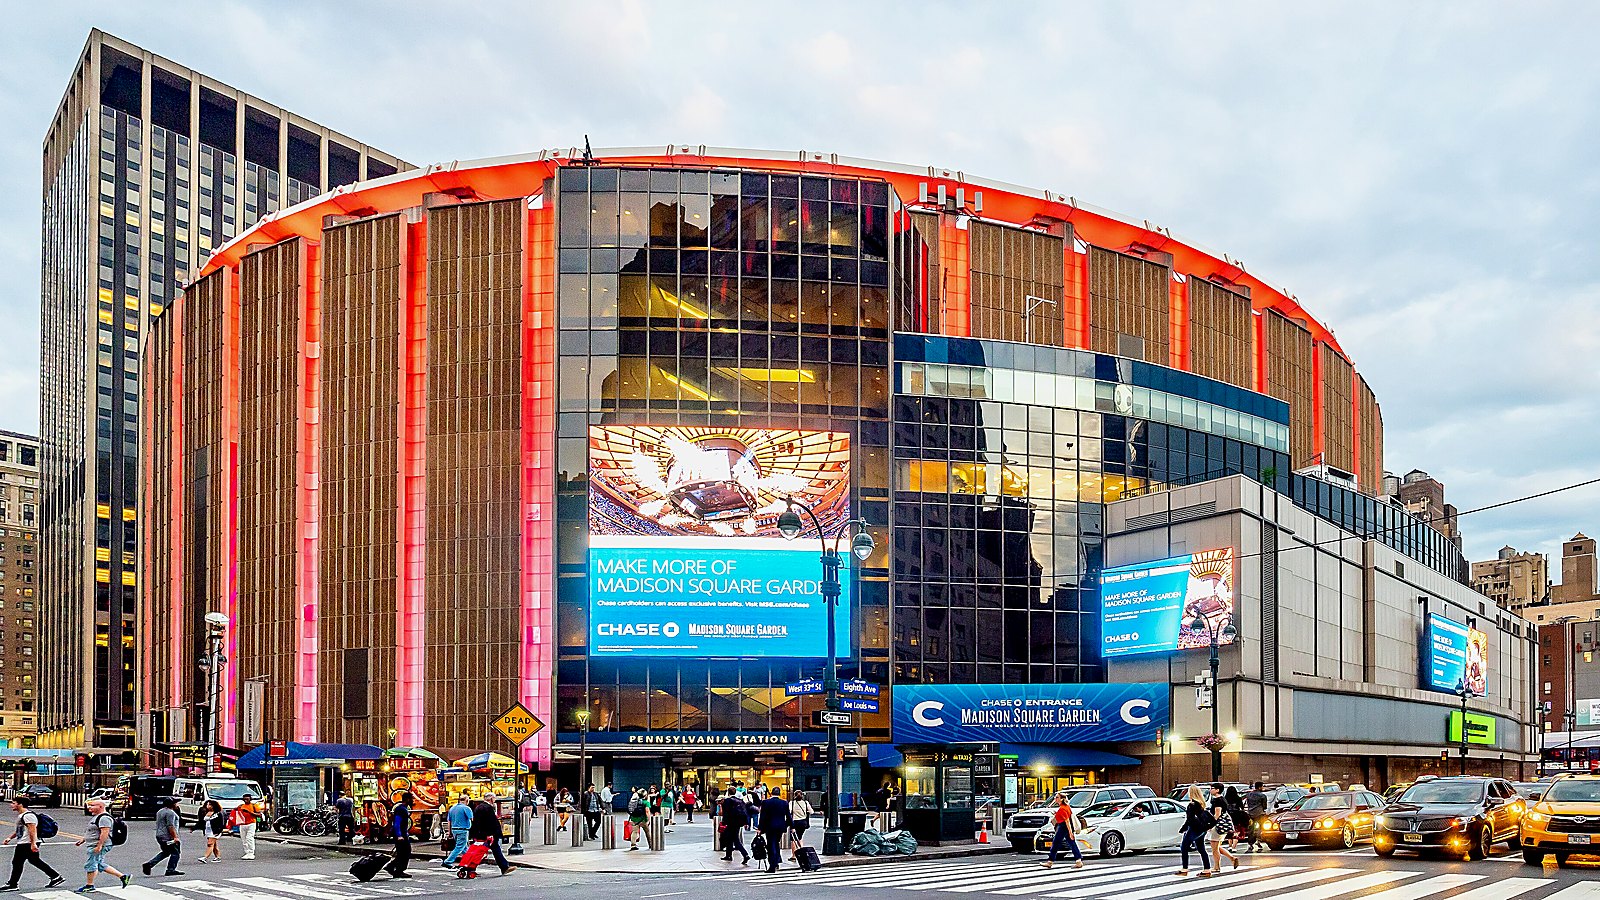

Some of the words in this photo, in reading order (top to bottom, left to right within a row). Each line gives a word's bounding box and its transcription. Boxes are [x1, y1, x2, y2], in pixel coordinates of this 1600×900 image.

[597, 559, 648, 574] MAKE
[652, 559, 707, 575] MORE
[711, 559, 737, 575] OF
[597, 578, 684, 593] MADISON
[688, 578, 762, 596] SQUARE
[766, 579, 824, 595] GARDE
[1105, 593, 1121, 601] MAKE
[1121, 590, 1138, 599] MORE
[1139, 589, 1148, 597] OF
[1105, 599, 1132, 608] MADISON
[1132, 594, 1156, 605] SQUARE
[1156, 591, 1182, 600] GARDEN
[597, 623, 661, 636] CHASE
[688, 623, 724, 635] MADISON
[725, 623, 755, 636] SQUARE
[1105, 633, 1131, 643] CHASE
[788, 684, 803, 693] West
[815, 682, 822, 690] St
[843, 682, 863, 693] Eighth
[864, 684, 877, 693] Ave
[843, 701, 852, 709] Joe
[853, 701, 867, 709] Louis
[981, 699, 1012, 707] CHASE
[912, 700, 945, 727] C
[961, 708, 1011, 724] MADISON
[1013, 708, 1055, 724] SQUARE
[1120, 698, 1151, 725] C
[504, 716, 531, 724] DEAD
[507, 726, 528, 734] END
[629, 735, 730, 743] PENNSYLVANIA
[735, 735, 788, 743] STATION
[386, 759, 426, 769] ALAFEL
